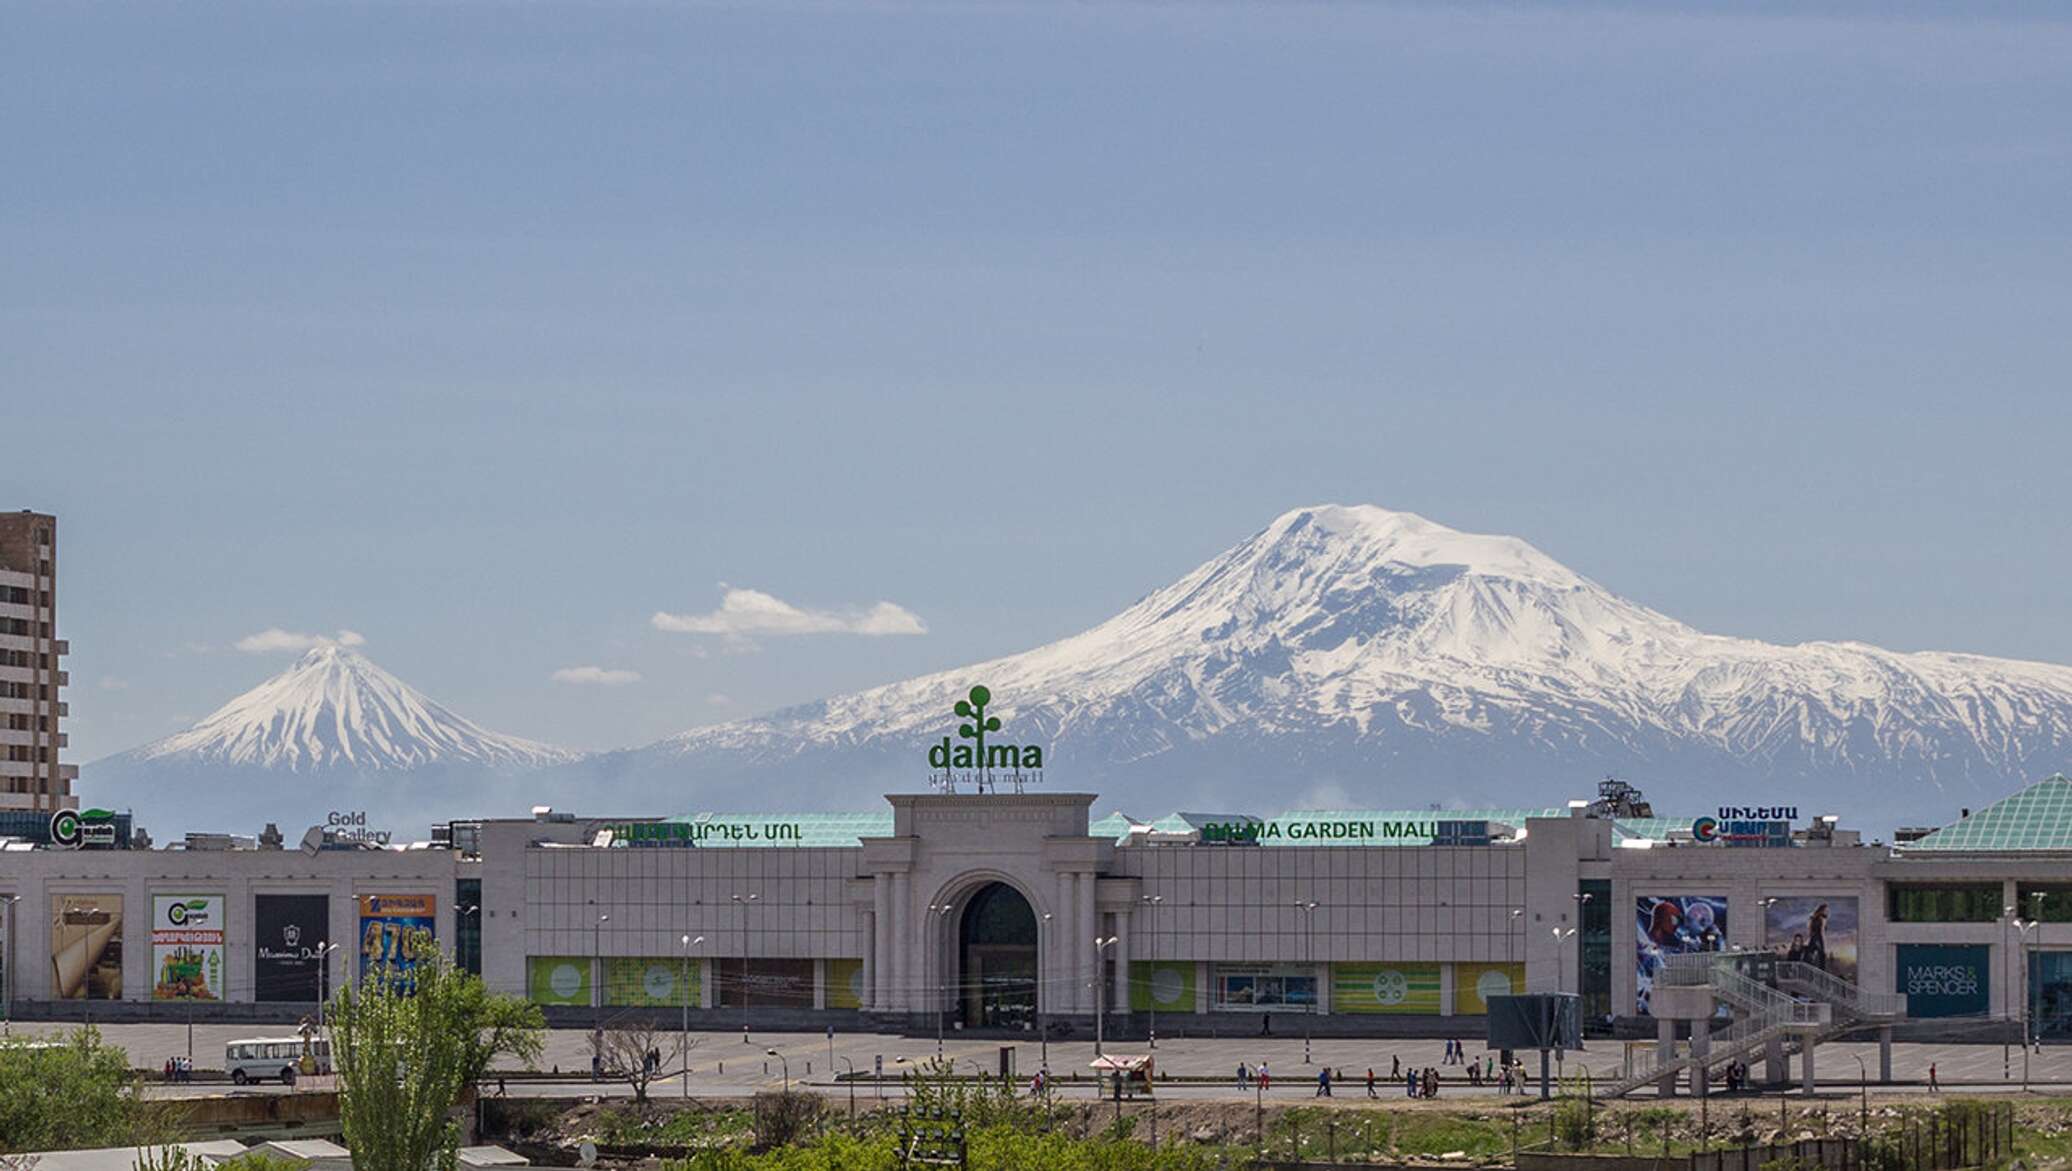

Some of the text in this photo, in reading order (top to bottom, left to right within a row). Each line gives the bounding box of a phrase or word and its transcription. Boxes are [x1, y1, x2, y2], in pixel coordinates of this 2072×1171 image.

[928, 737, 1042, 768] dalma
[328, 811, 366, 826] Gold
[1718, 807, 1799, 820] ՍԻՆԵՄԱ
[765, 823, 803, 840] ՄՈԼ
[1287, 822, 1375, 839] GARDEN
[1383, 822, 1438, 839] MALL
[1907, 980, 1979, 995] SPENCER
